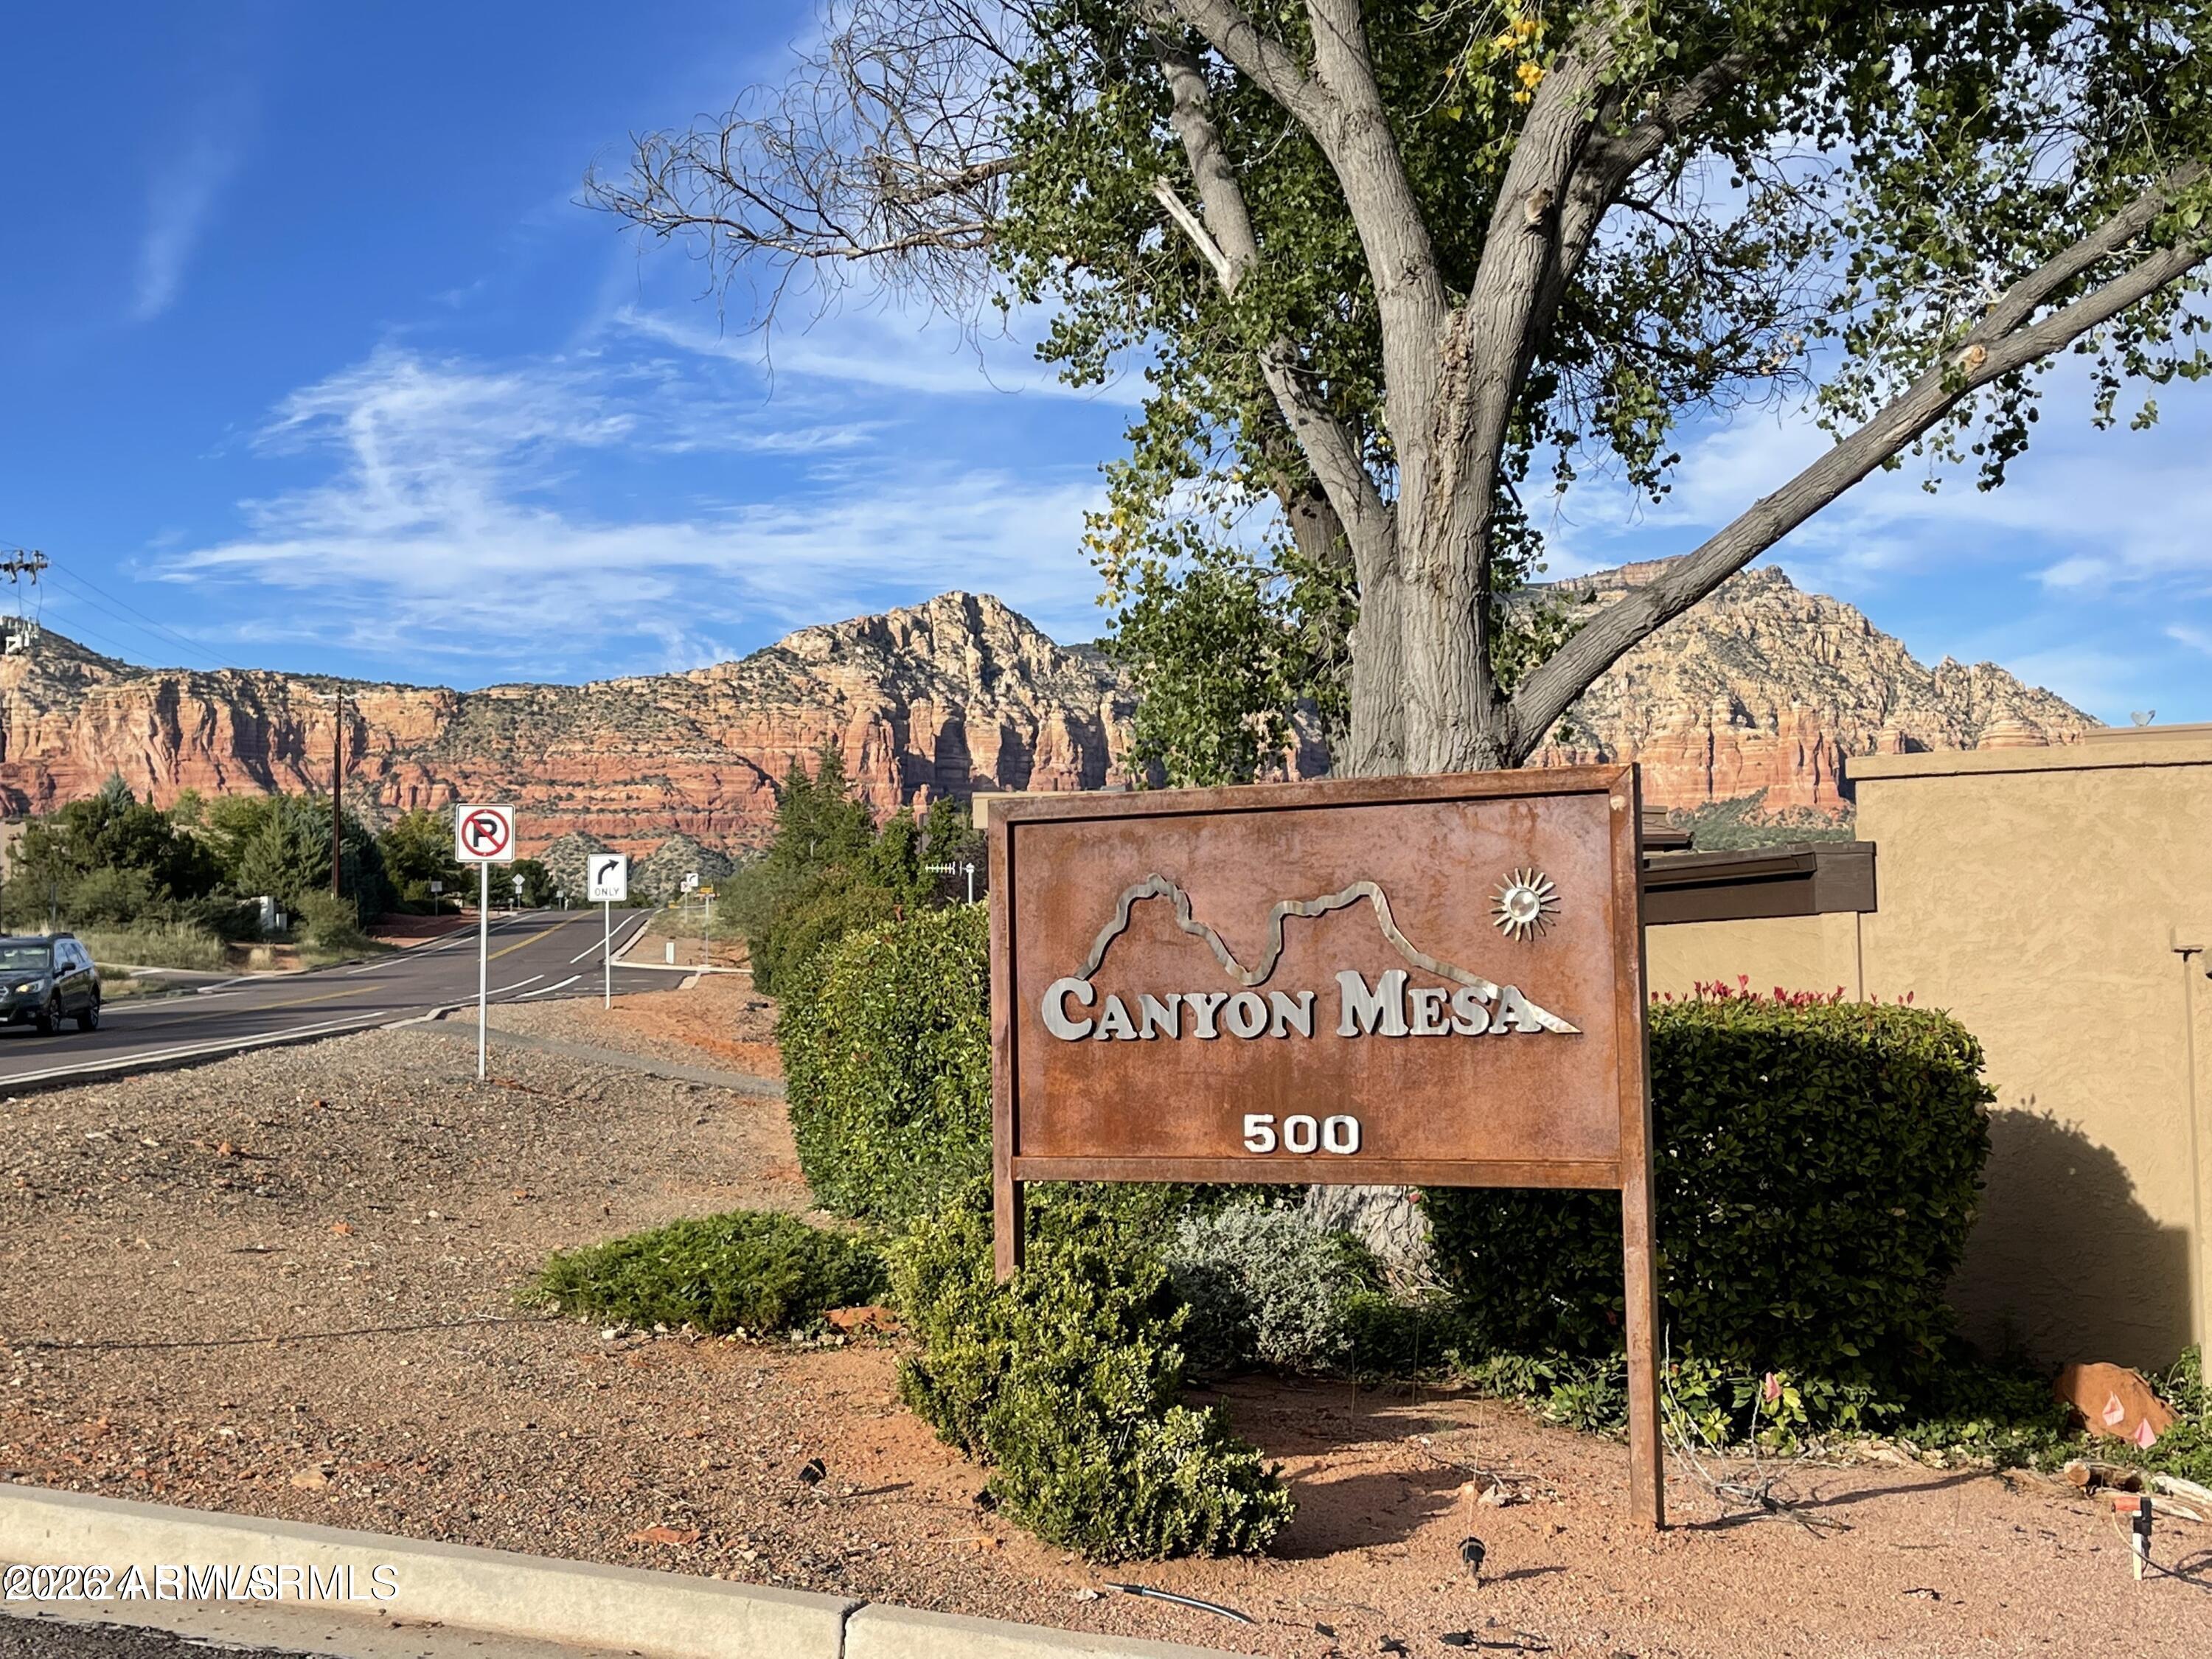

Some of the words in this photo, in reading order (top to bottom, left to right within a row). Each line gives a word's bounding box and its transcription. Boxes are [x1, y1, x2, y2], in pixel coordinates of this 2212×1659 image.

[594, 887, 620, 897] ONLY
[1041, 977, 1315, 1041] CANYON
[1335, 969, 1544, 1038] MESA
[1243, 1113, 1362, 1155] 500
